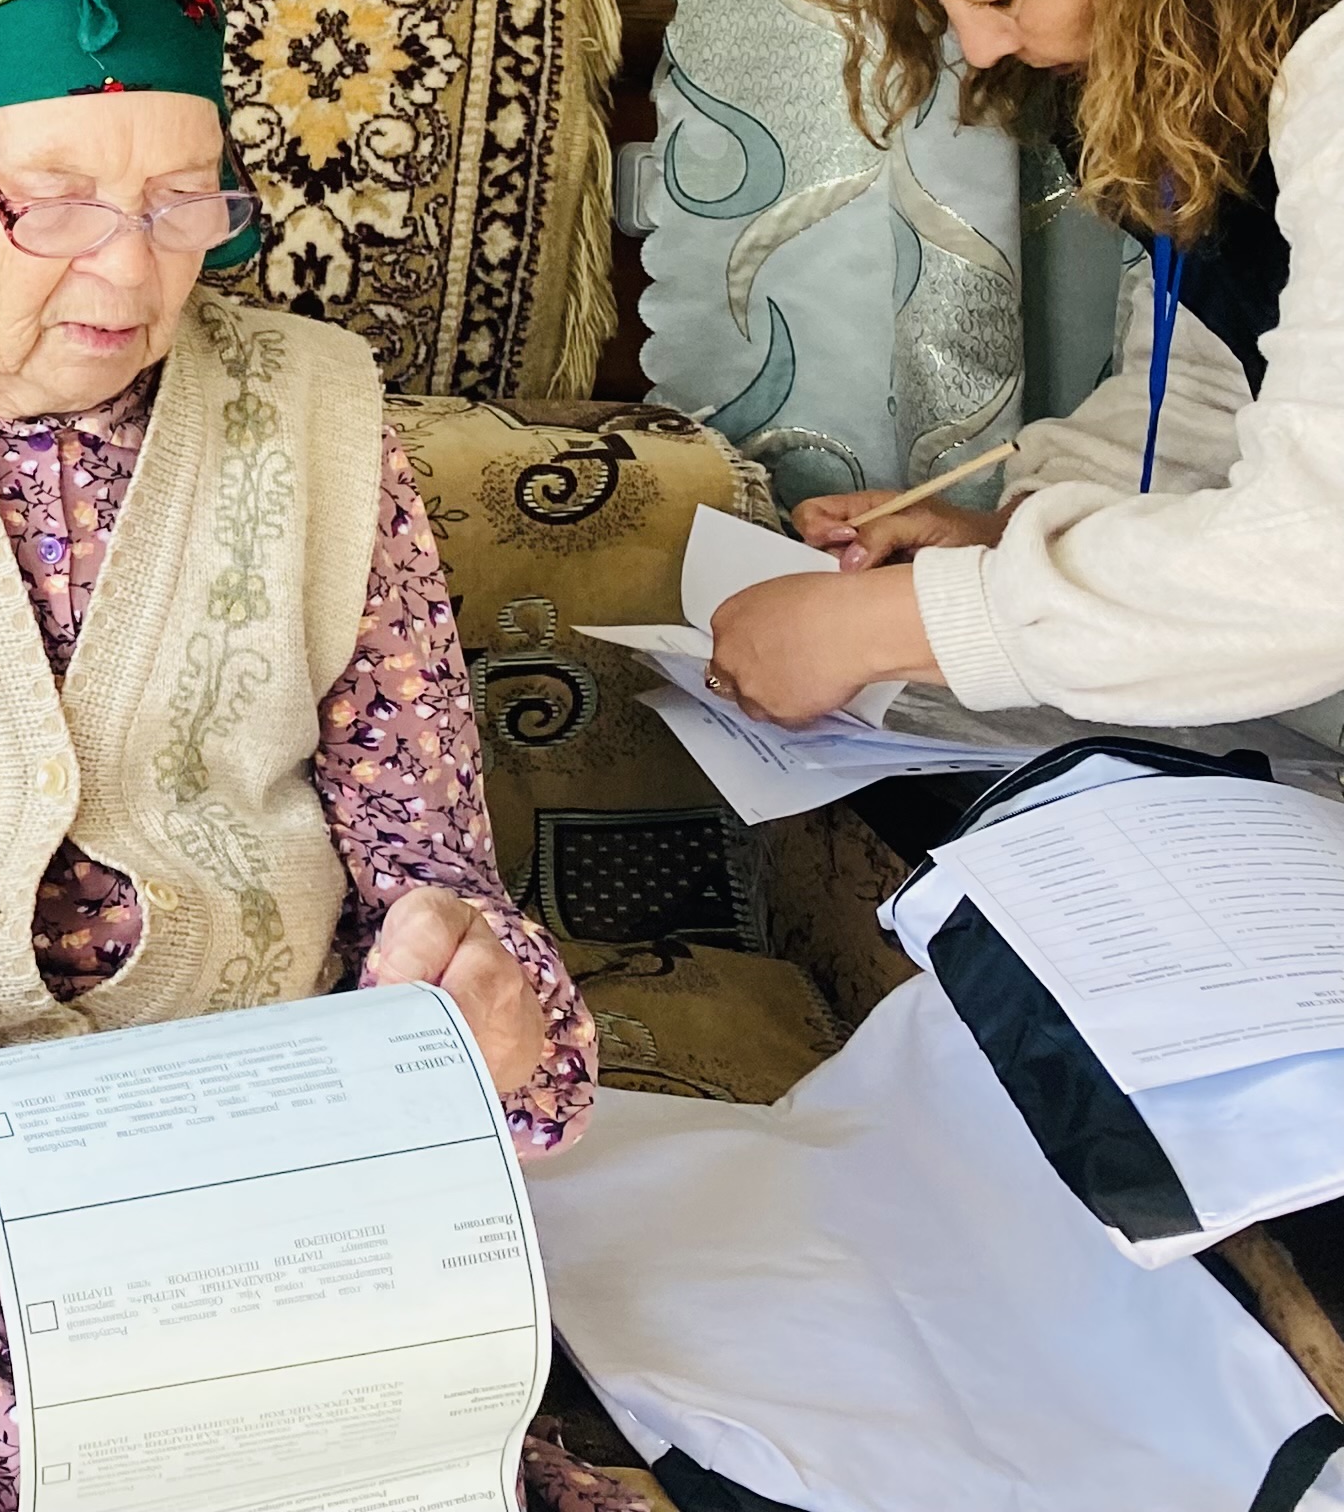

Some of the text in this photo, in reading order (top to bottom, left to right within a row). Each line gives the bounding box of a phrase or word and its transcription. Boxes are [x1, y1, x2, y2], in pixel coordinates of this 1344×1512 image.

[394, 1053, 466, 1074] ГАЛИКЕЕВ
[216, 1095, 249, 1107] город
[26, 1137, 88, 1154] Республика
[293, 1224, 386, 1250] ПЕНСИОНЕРОВ
[274, 1249, 324, 1268] ПАРТИЯ
[442, 1246, 520, 1270] БИККИНИН
[200, 1270, 286, 1294] «КВАДРАТНЫЕ
[274, 1281, 304, 1294] город
[338, 1285, 361, 1297] года
[373, 1279, 396, 1292] 1966
[62, 1285, 114, 1304] ПАРТИИ
[170, 1296, 224, 1312] Общество
[66, 1310, 139, 1330] ограниченной
[68, 1325, 128, 1344] Республика
[77, 1435, 128, 1452] ПАРТИИ
